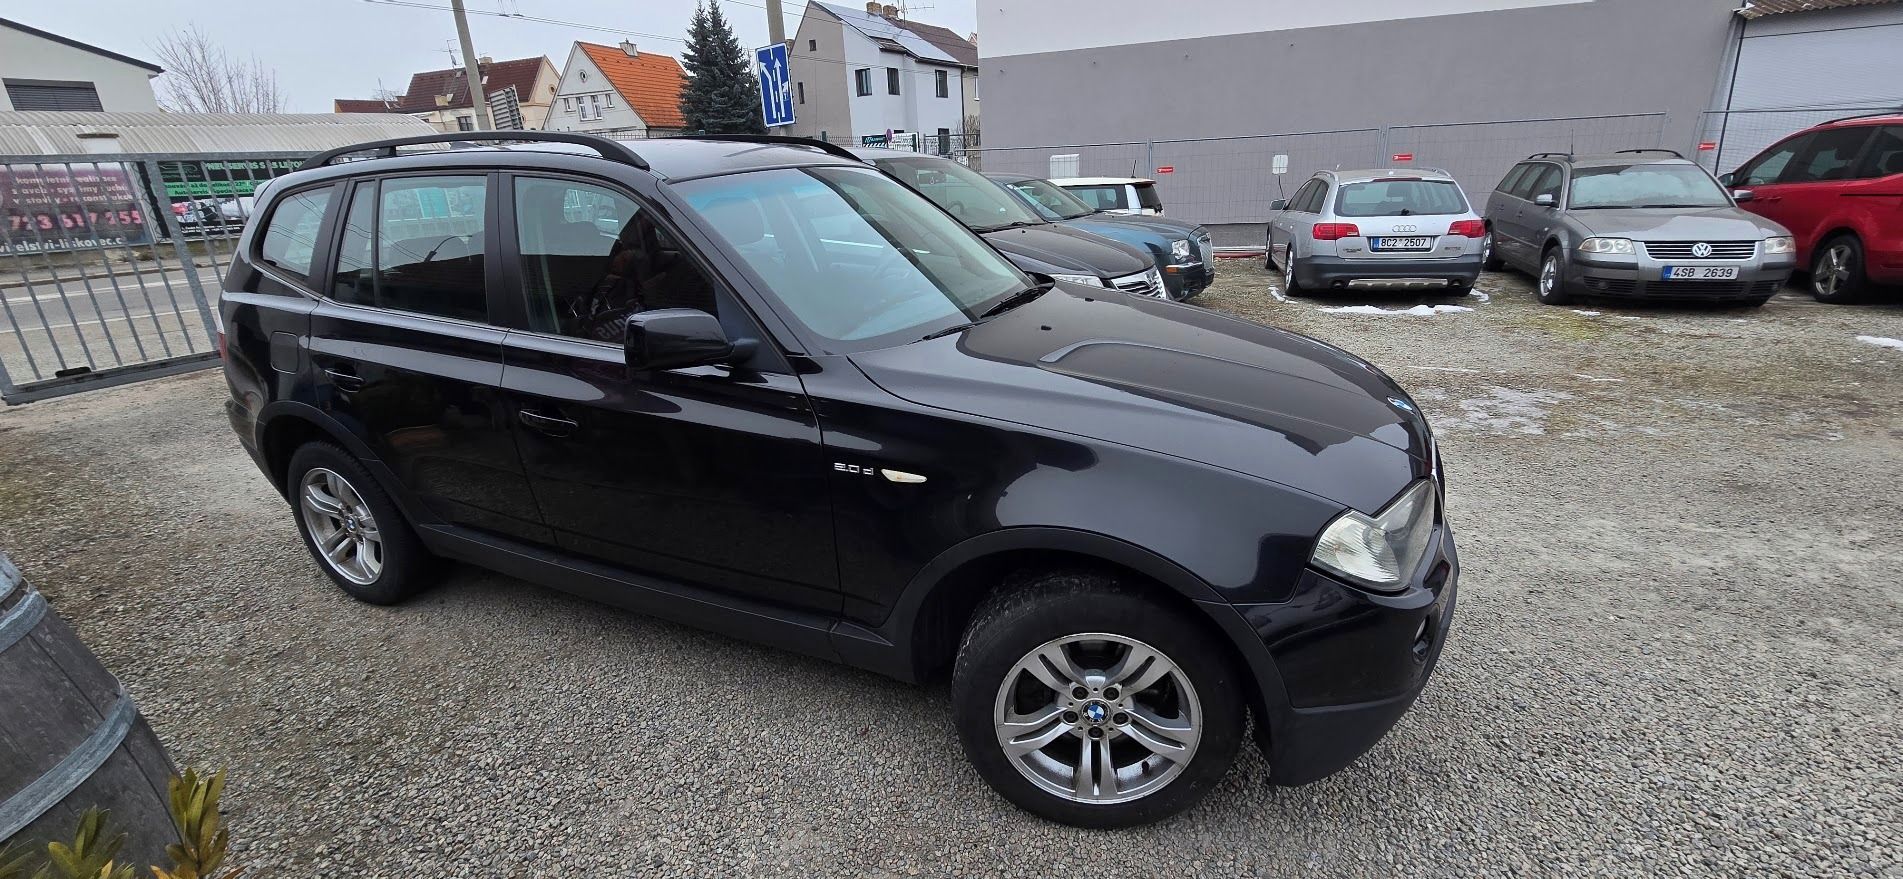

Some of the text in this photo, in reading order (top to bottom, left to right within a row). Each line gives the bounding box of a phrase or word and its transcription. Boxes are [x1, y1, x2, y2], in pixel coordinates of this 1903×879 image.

[1380, 238, 1427, 247] 8C2 2507
[1673, 267, 1734, 278] 4SB 2639
